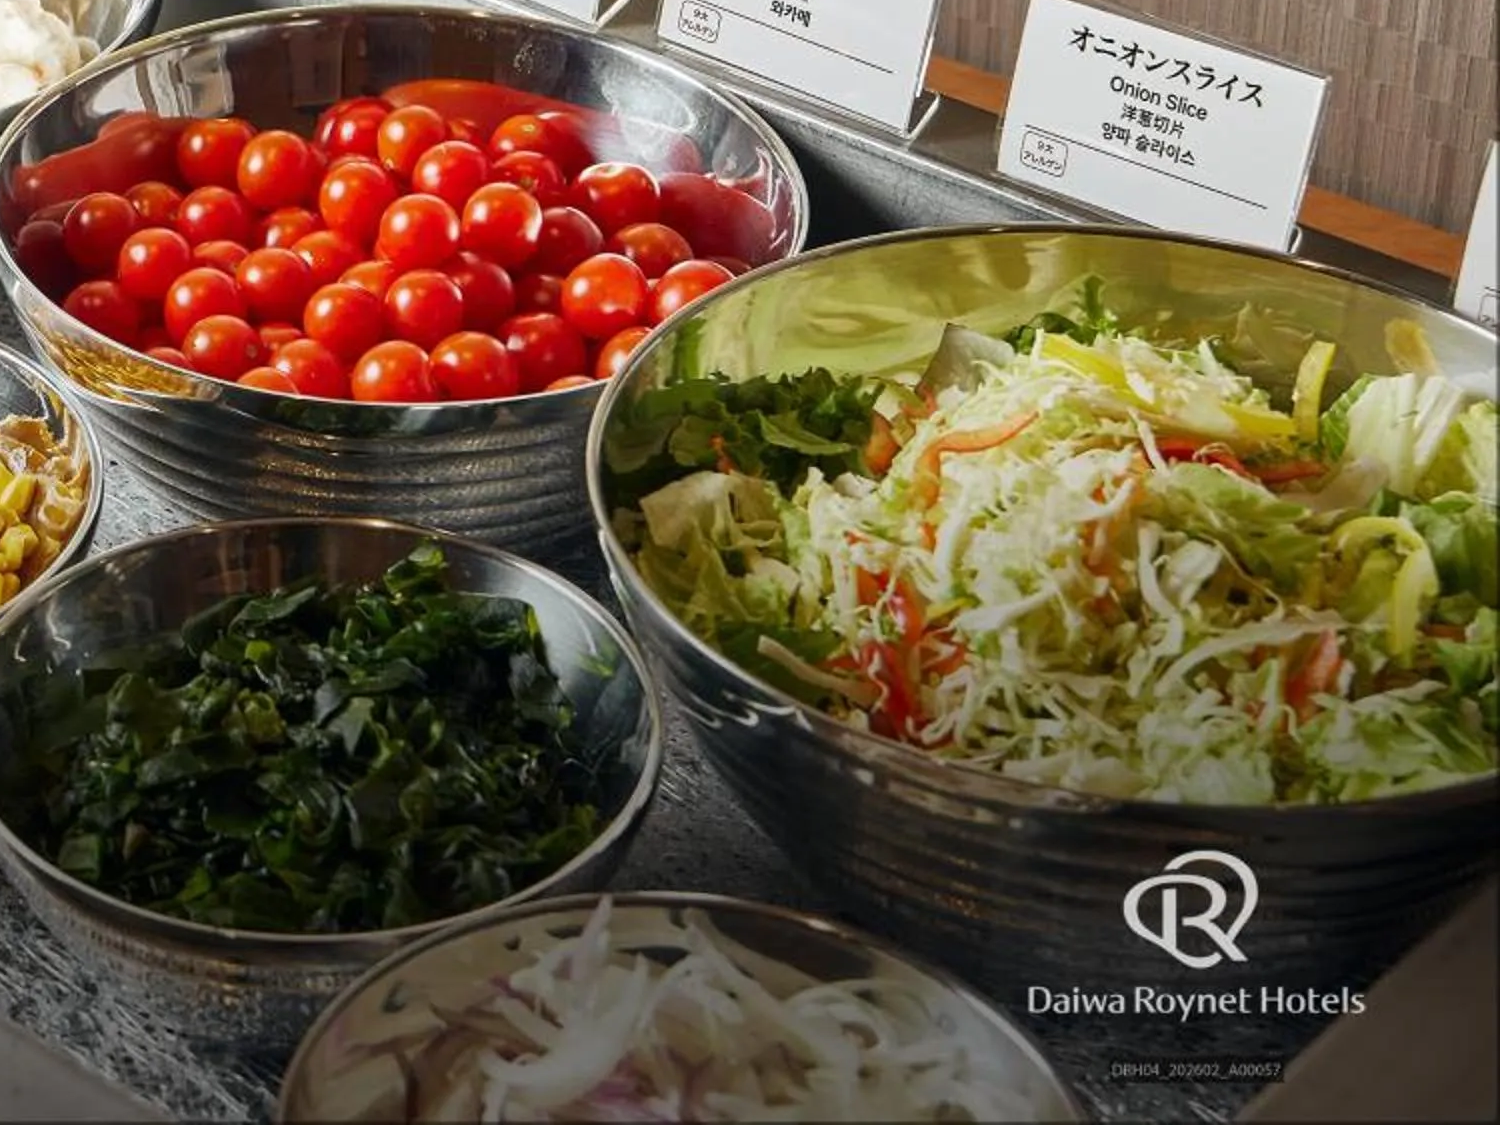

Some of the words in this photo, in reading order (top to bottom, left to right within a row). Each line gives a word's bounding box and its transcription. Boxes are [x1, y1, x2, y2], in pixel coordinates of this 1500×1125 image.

[1069, 25, 1265, 109] オニオンスライス
[1109, 75, 1162, 107] Onion
[1165, 92, 1209, 122] Slice
[1101, 121, 1132, 147] 양파
[1134, 132, 1196, 168] 슬라이스
